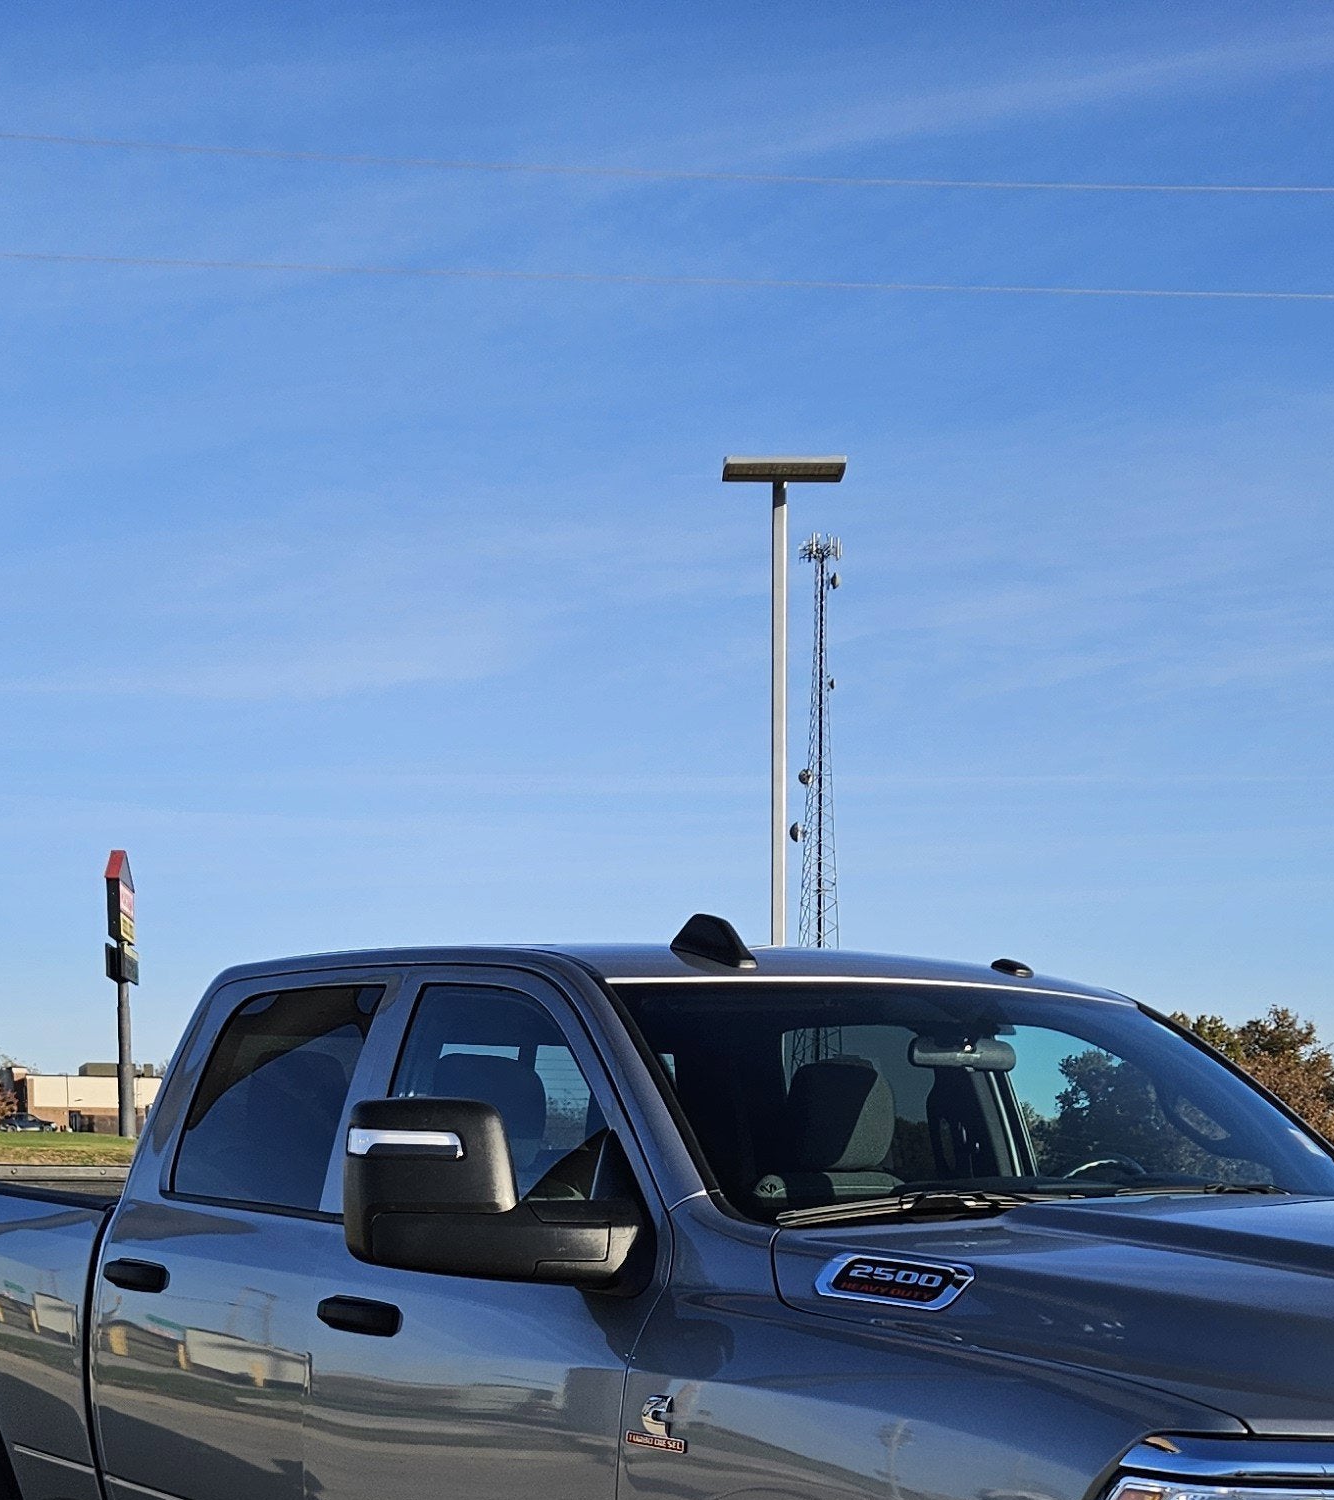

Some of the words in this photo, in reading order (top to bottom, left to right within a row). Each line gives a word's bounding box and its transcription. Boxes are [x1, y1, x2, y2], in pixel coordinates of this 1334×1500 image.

[848, 1264, 943, 1288] 2500
[840, 1280, 889, 1296] HEAVY
[890, 1286, 935, 1300] DUTY
[629, 1433, 653, 1445] TURBO
[654, 1438, 683, 1450] DIESEL
